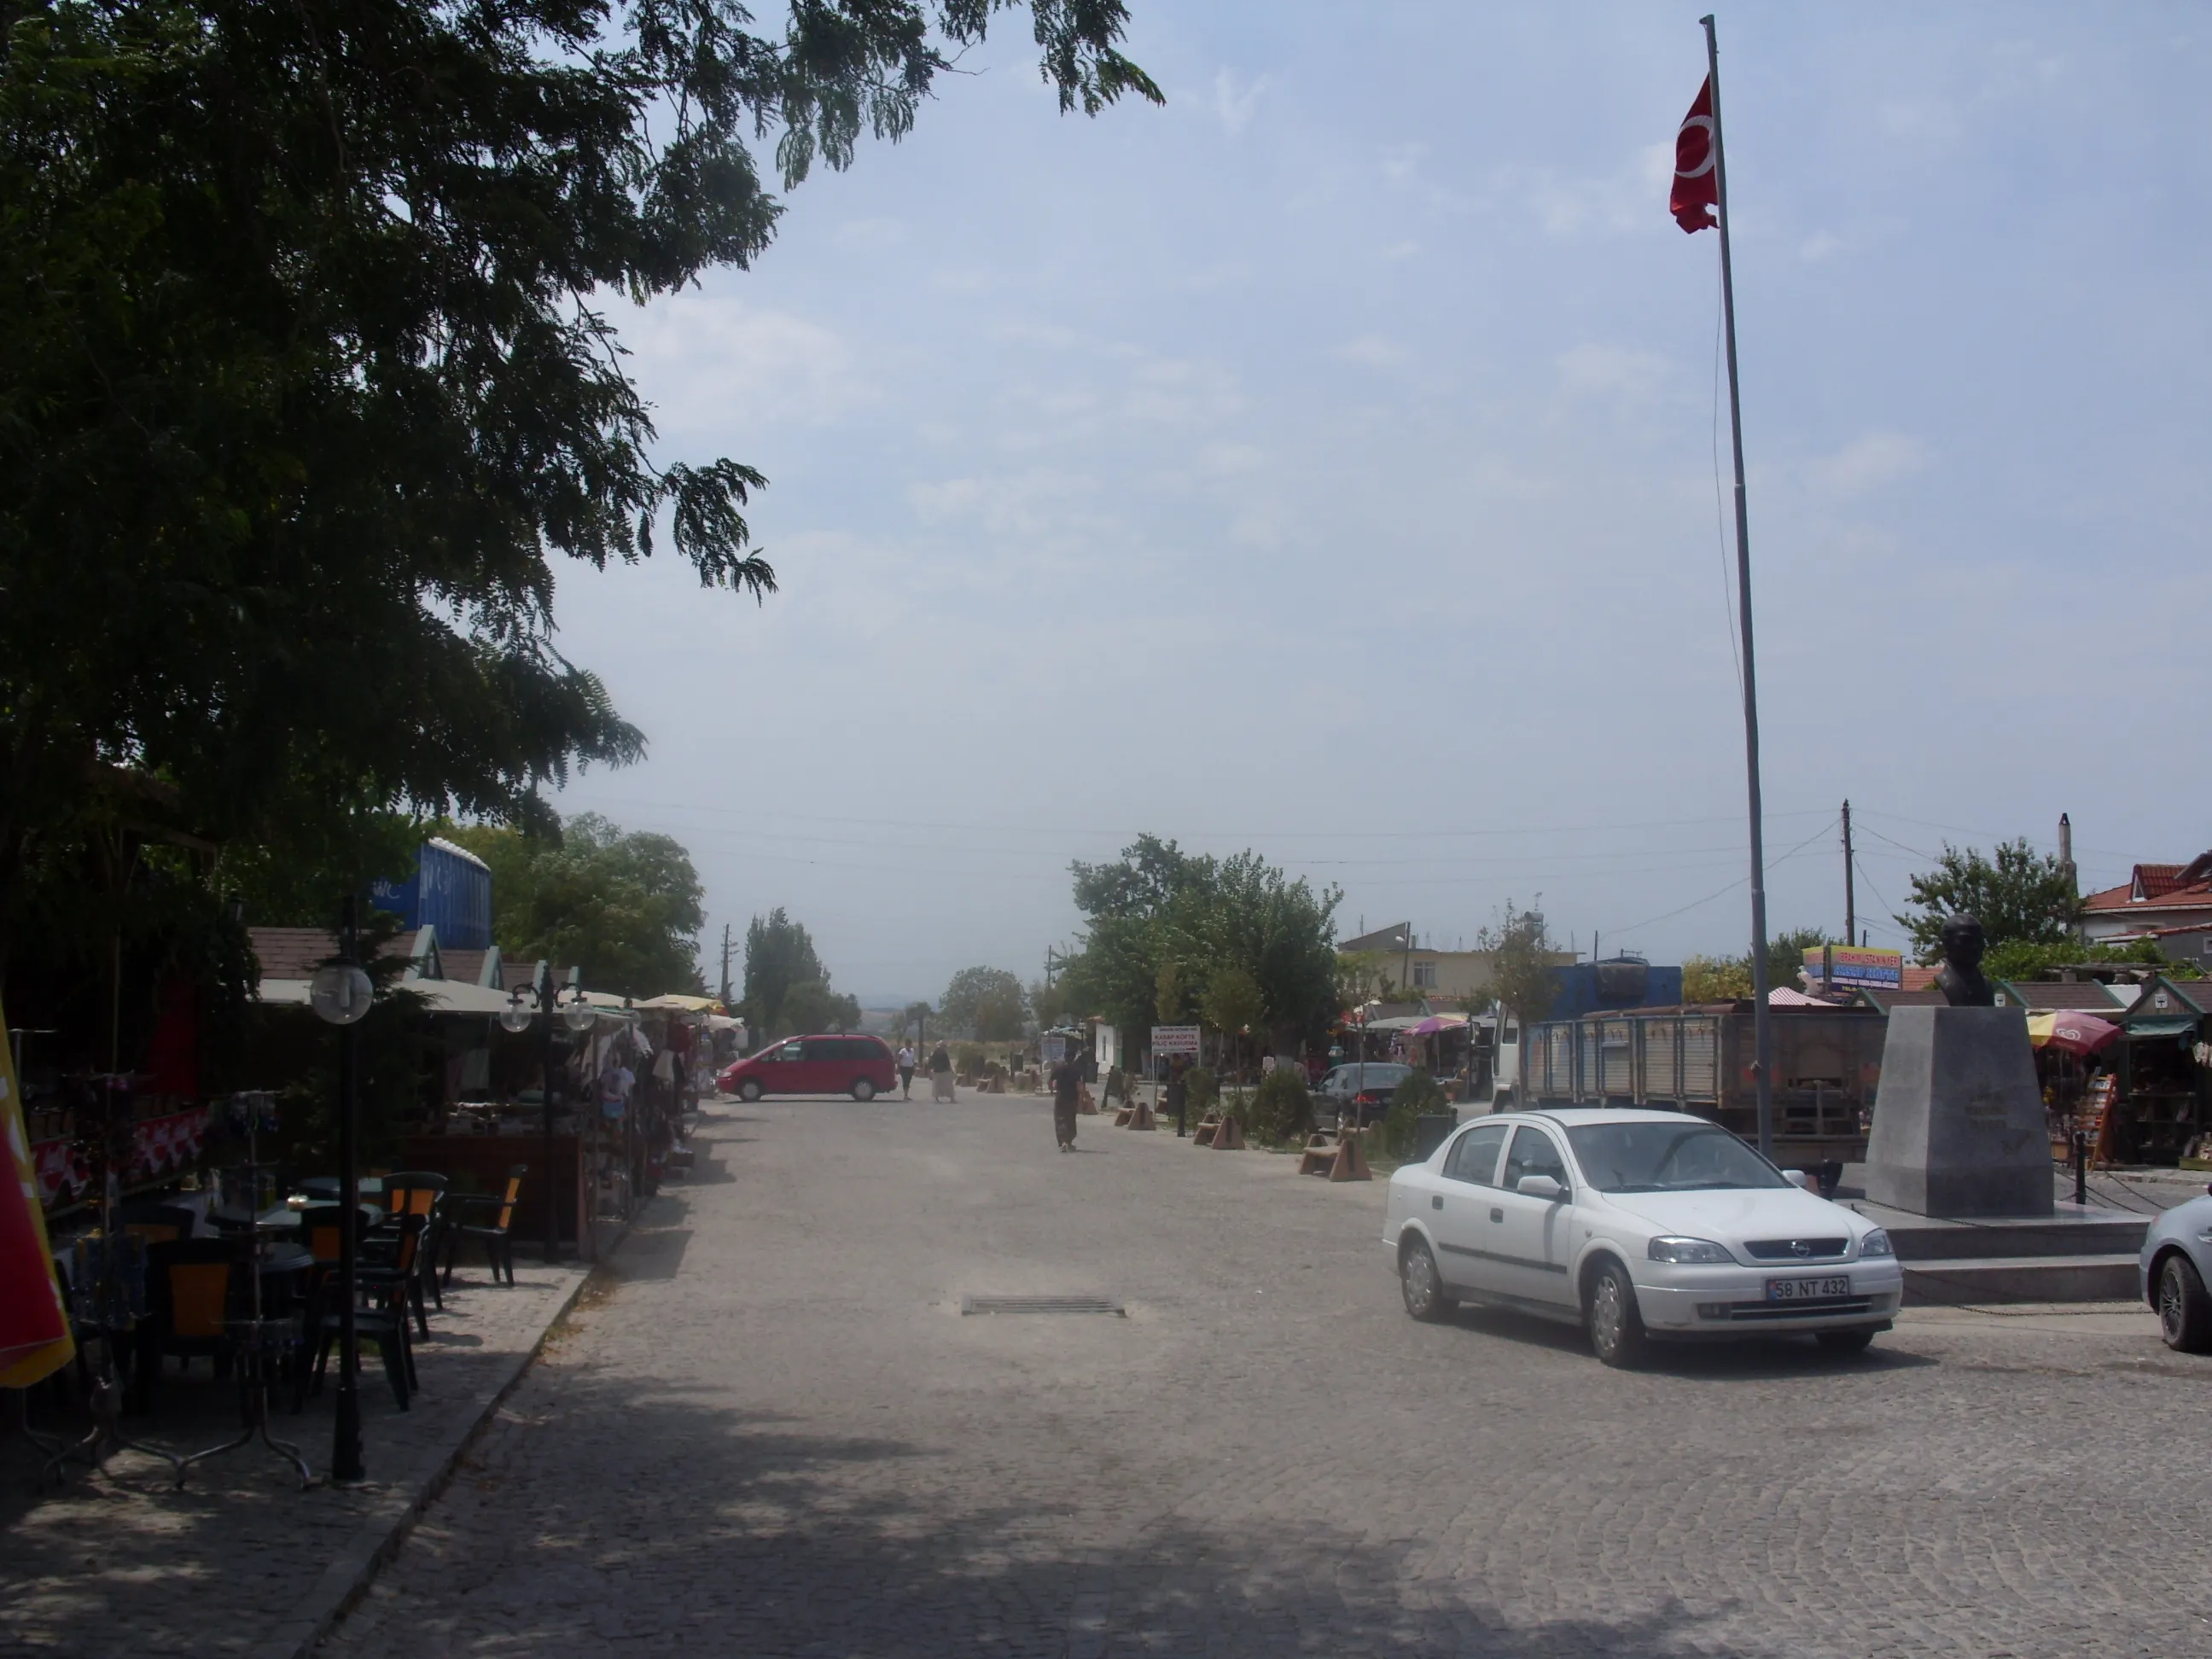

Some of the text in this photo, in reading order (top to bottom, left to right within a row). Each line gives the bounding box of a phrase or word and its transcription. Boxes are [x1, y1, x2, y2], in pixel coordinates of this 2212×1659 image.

[373, 881, 400, 899] WC
[1777, 1279, 1846, 1297] 58 NT 432
